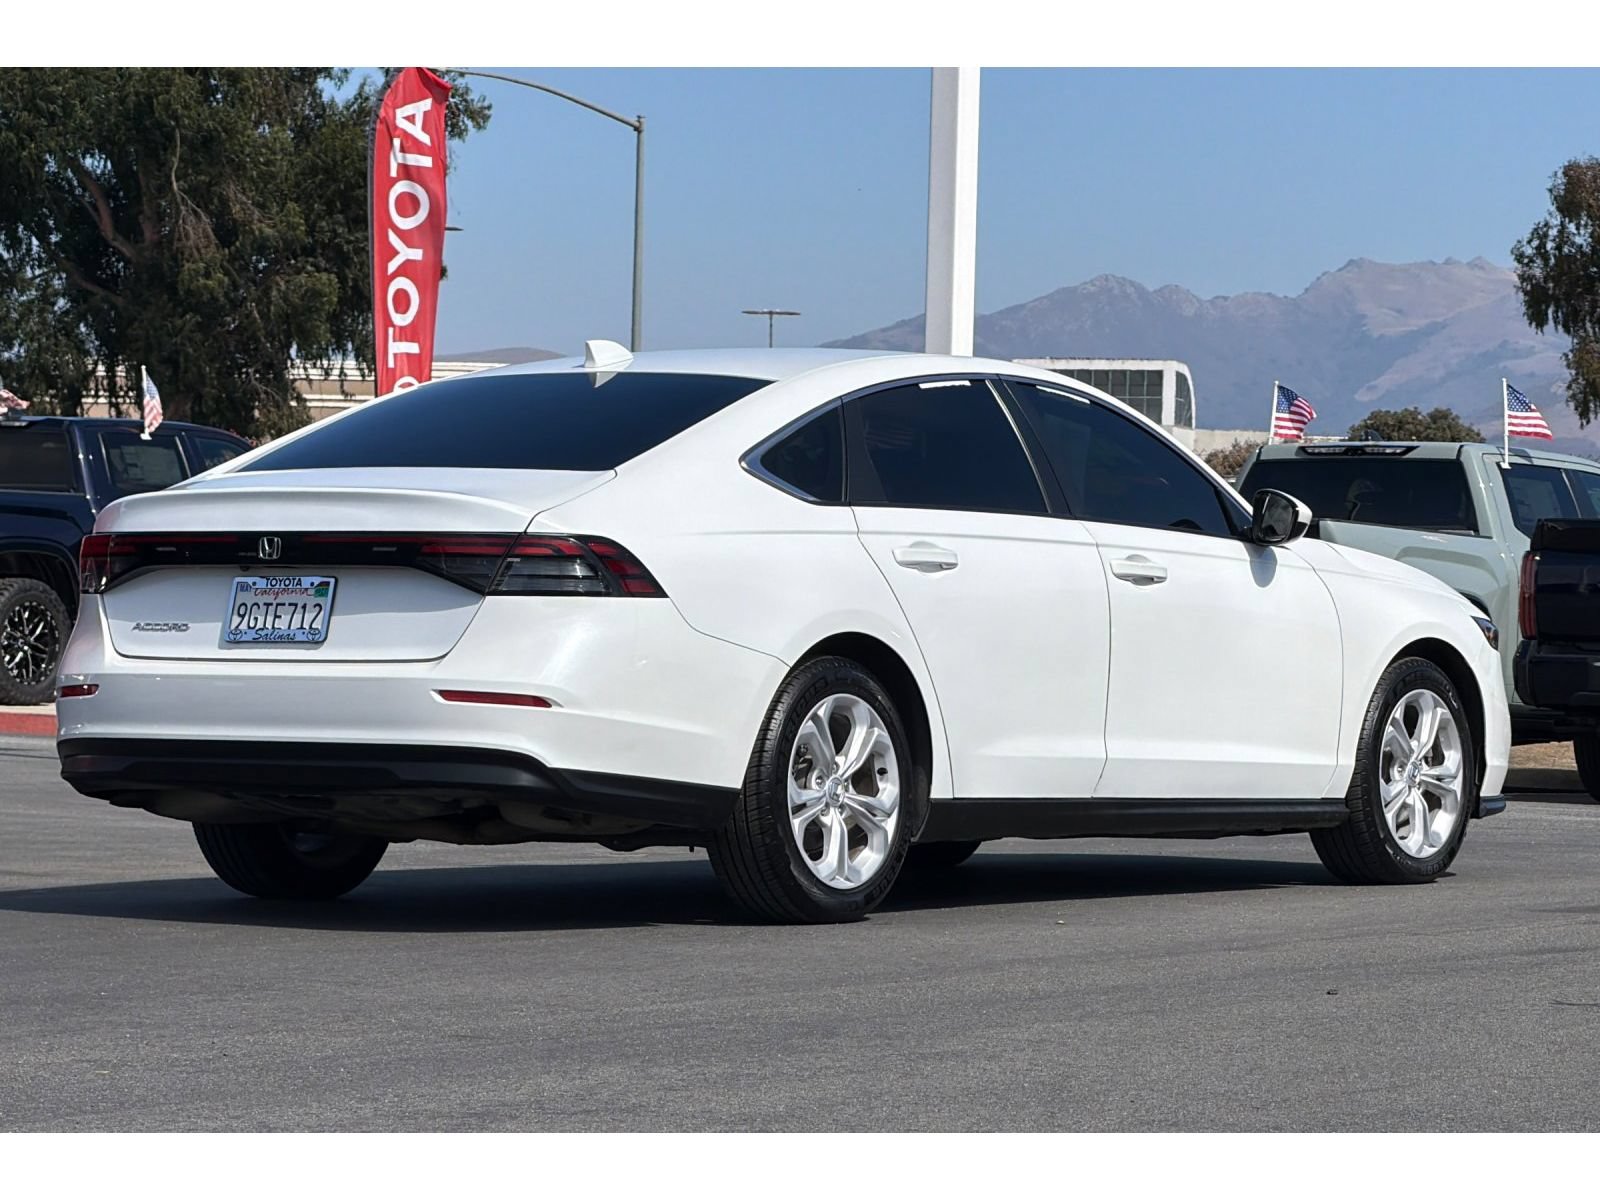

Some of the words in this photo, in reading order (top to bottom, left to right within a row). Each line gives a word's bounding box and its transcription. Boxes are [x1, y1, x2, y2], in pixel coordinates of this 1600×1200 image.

[387, 97, 433, 368] TOYOTA
[265, 577, 303, 588] TOYOTA
[254, 587, 315, 601] California
[131, 622, 191, 632] ACCORD
[251, 627, 296, 641] Salinas
